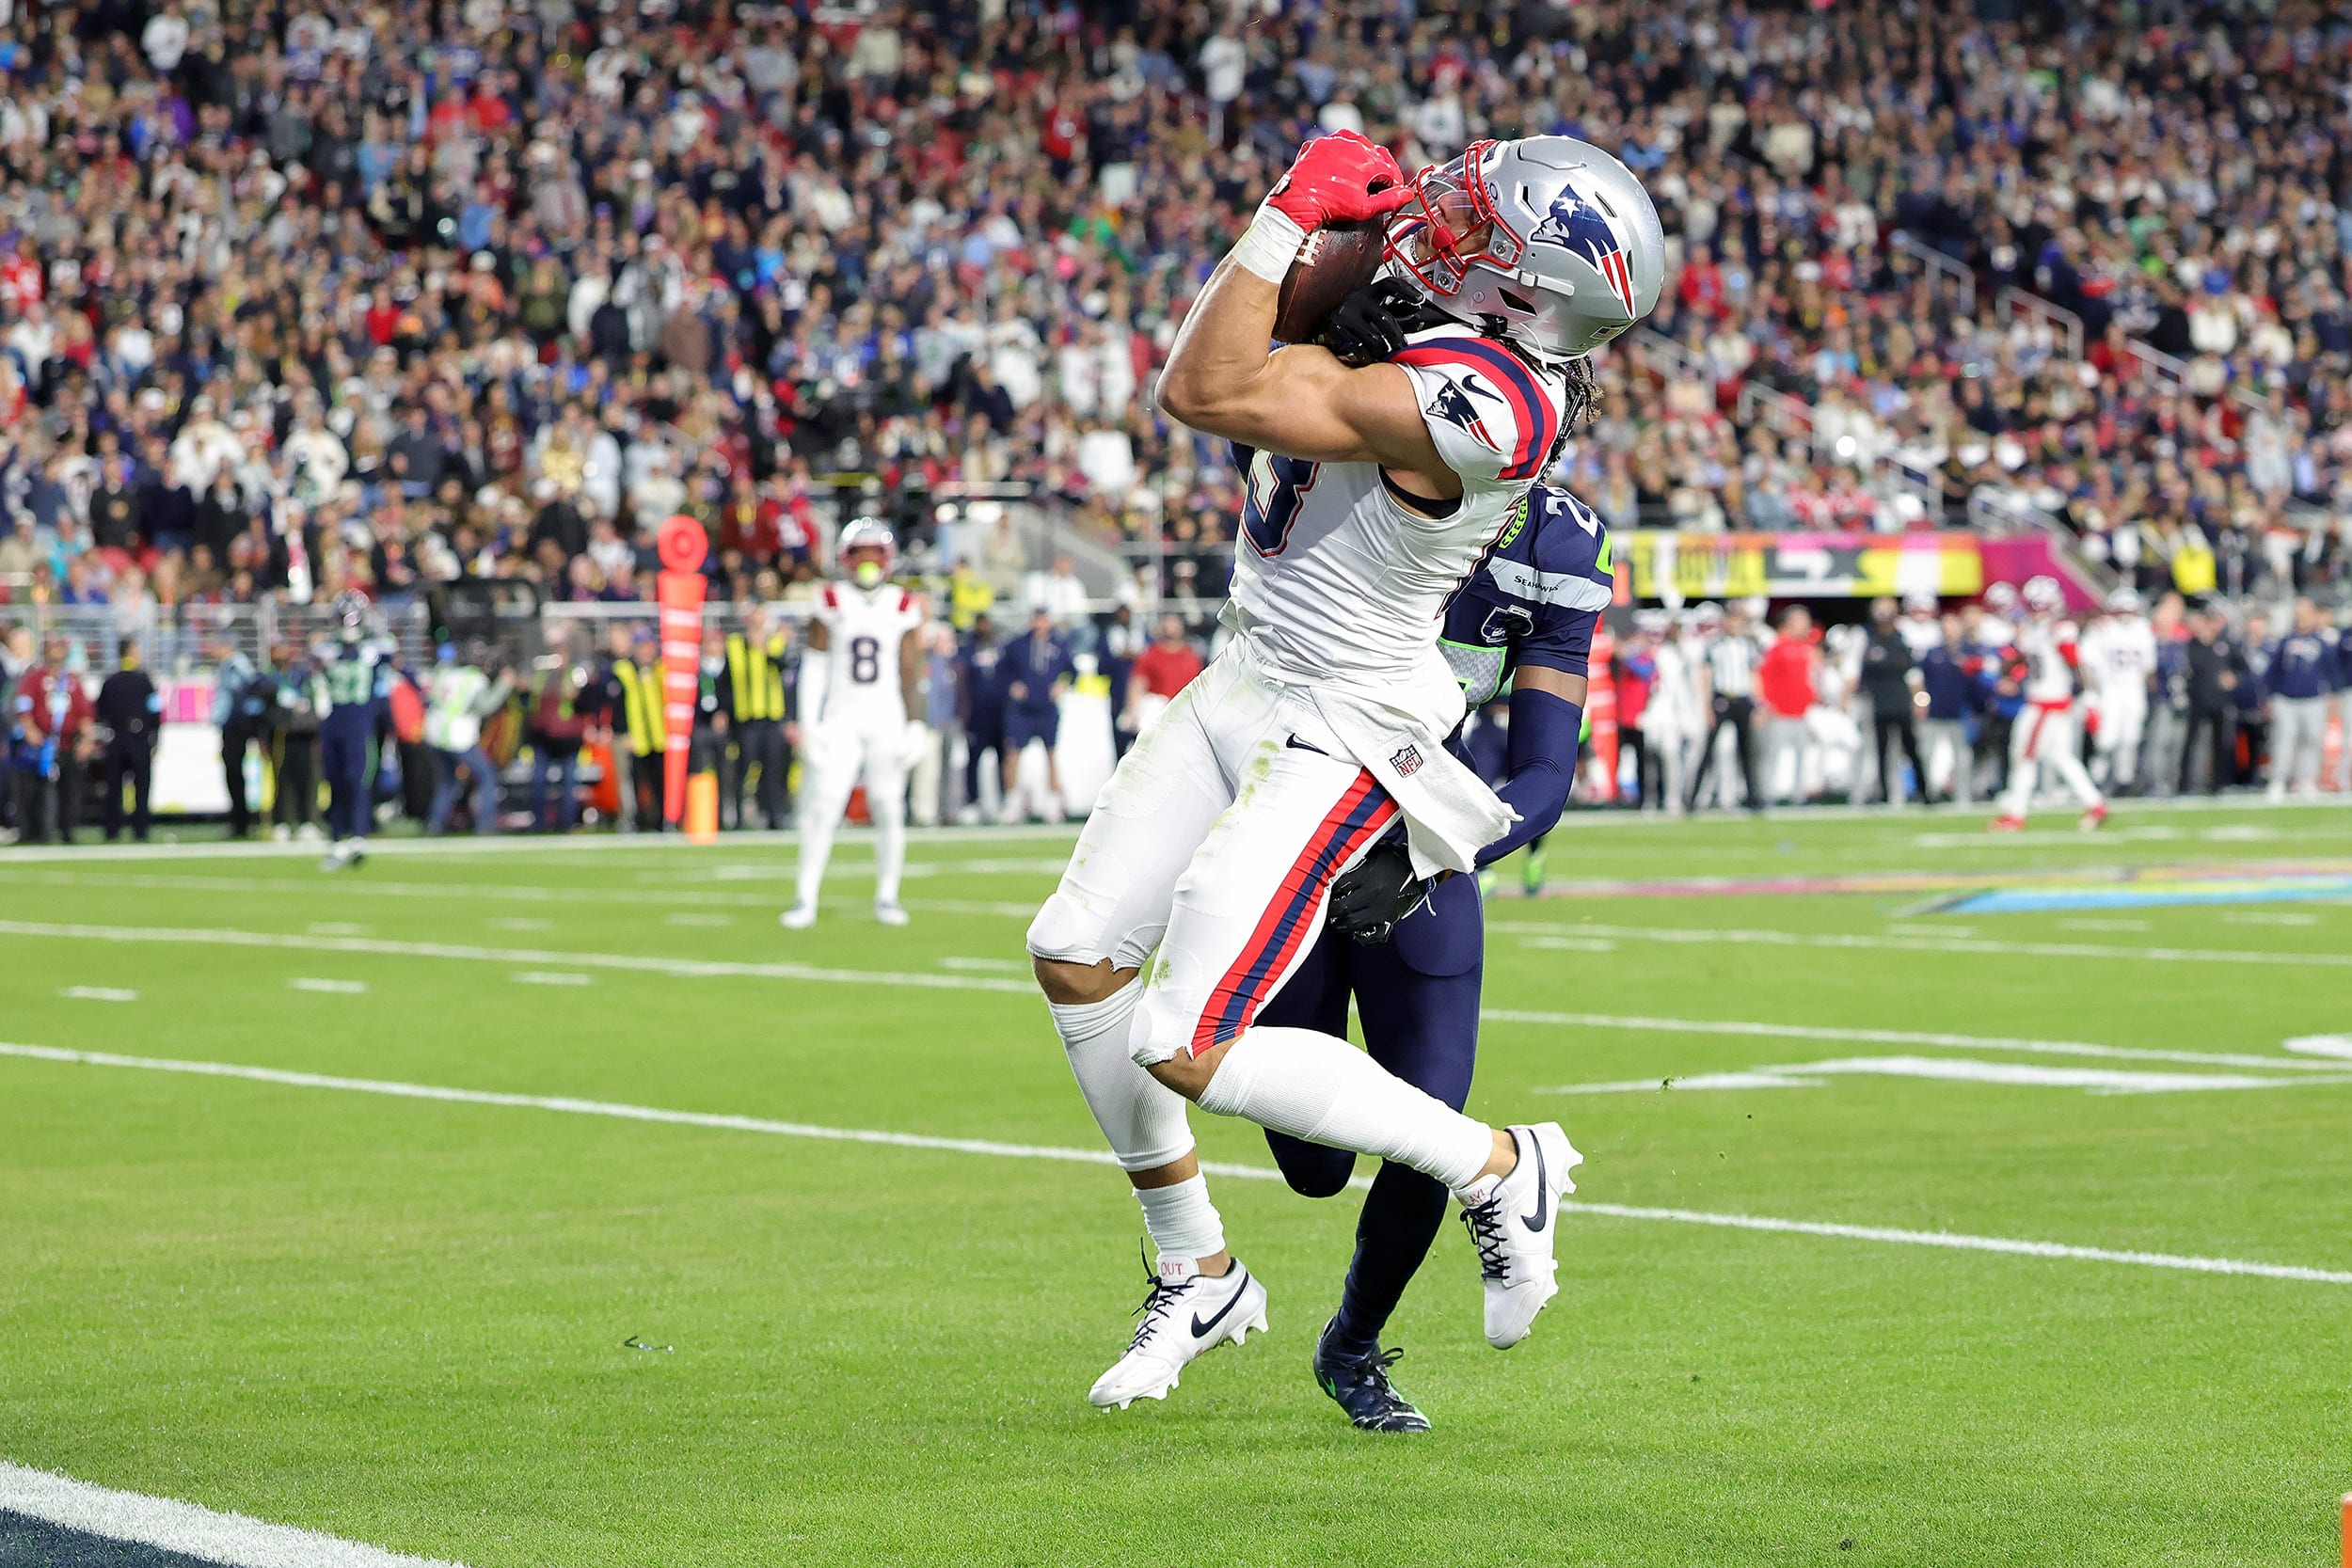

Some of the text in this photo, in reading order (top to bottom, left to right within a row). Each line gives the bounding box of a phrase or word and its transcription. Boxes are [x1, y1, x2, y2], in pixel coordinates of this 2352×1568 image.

[850, 635, 880, 685] 8
[1398, 755, 1422, 776] NFL
[1160, 1261, 1183, 1276] OUT
